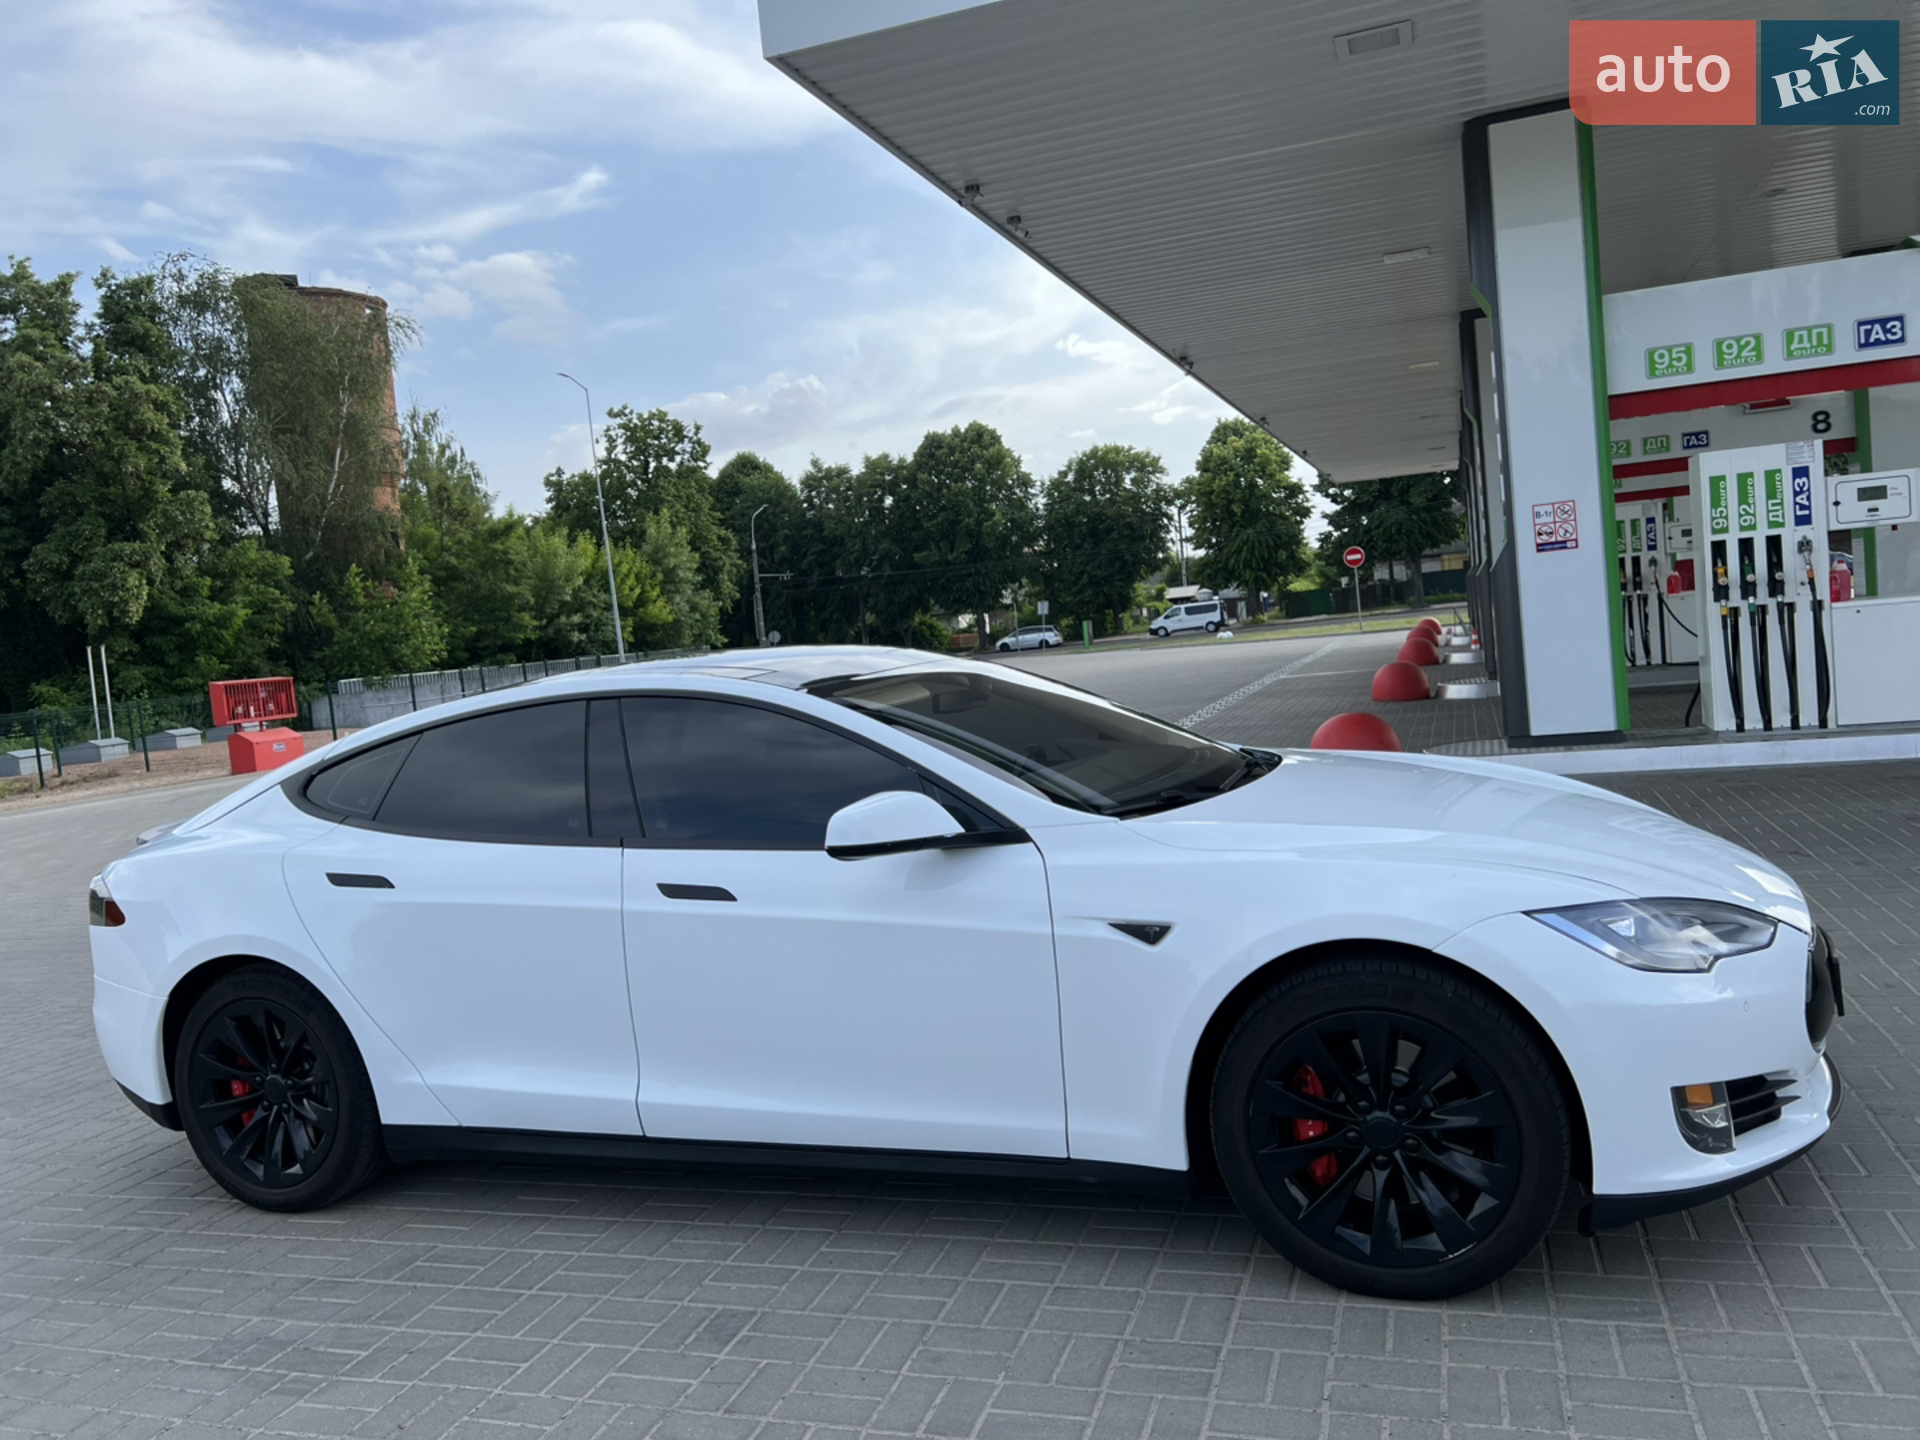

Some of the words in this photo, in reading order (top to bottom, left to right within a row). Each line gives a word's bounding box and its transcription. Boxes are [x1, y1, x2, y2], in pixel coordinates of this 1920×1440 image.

[1790, 328, 1830, 349] ДП
[1858, 320, 1903, 344] ГАЗ
[1653, 346, 1688, 369] 95
[1721, 336, 1757, 359] 92
[1793, 345, 1827, 357] euro
[1655, 364, 1688, 376] euro
[1723, 355, 1757, 366] euro
[1811, 410, 1832, 433] 8
[1683, 434, 1708, 447] ГАЗ
[1794, 476, 1810, 516] ГАЗ
